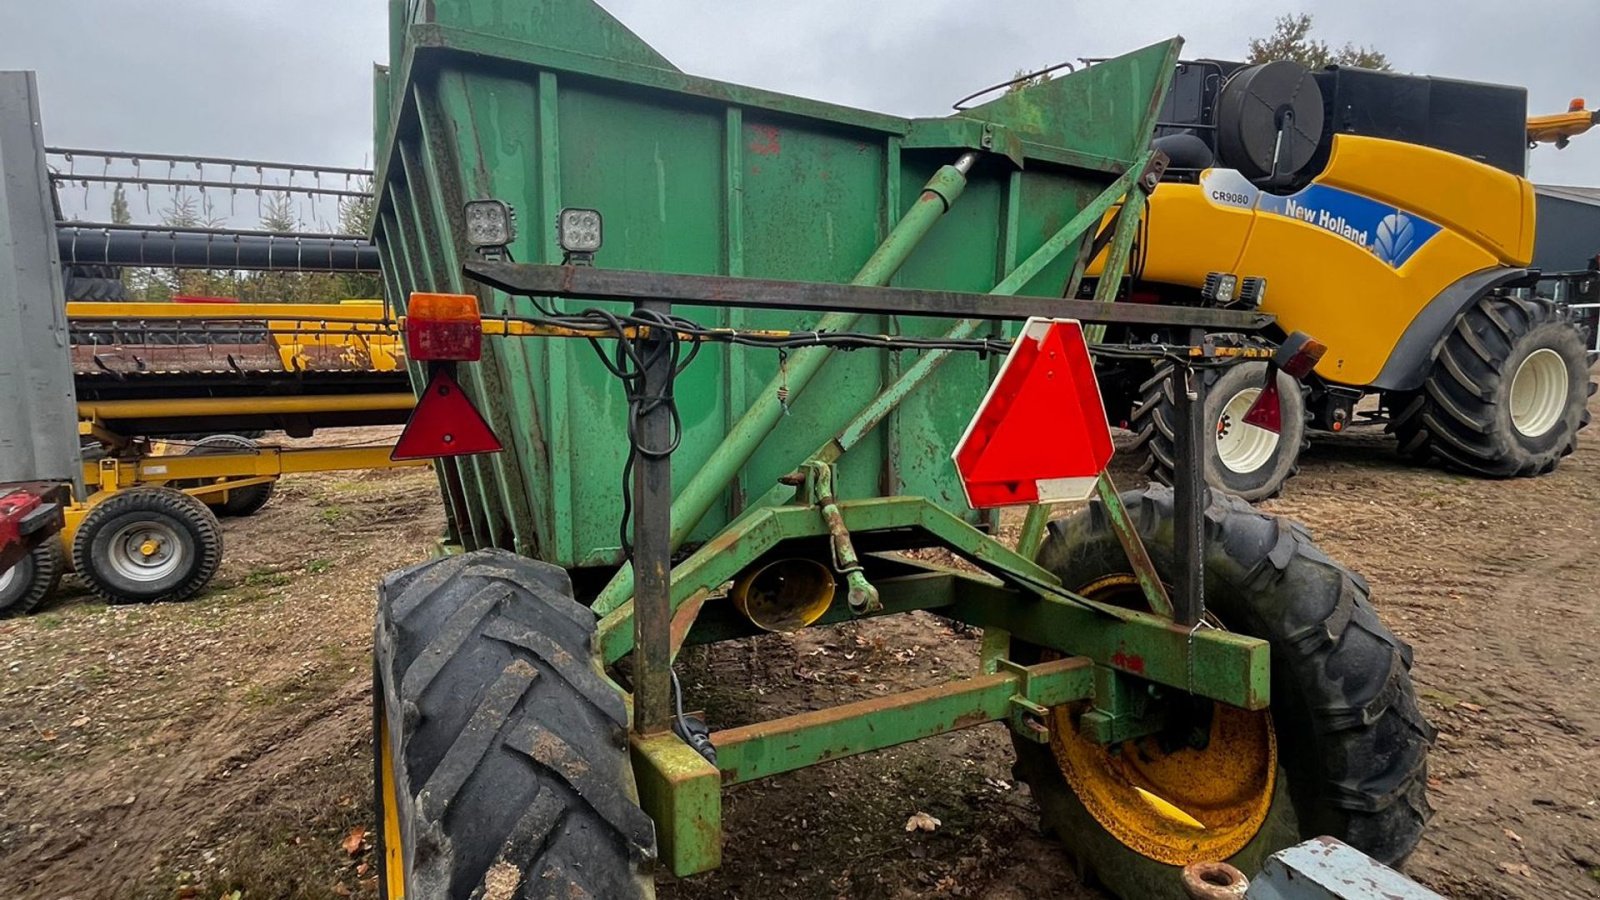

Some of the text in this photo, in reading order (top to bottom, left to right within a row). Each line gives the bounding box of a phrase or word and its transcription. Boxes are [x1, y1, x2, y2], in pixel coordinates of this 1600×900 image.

[1212, 190, 1249, 205] CR9080
[1285, 198, 1368, 246] New Holland
